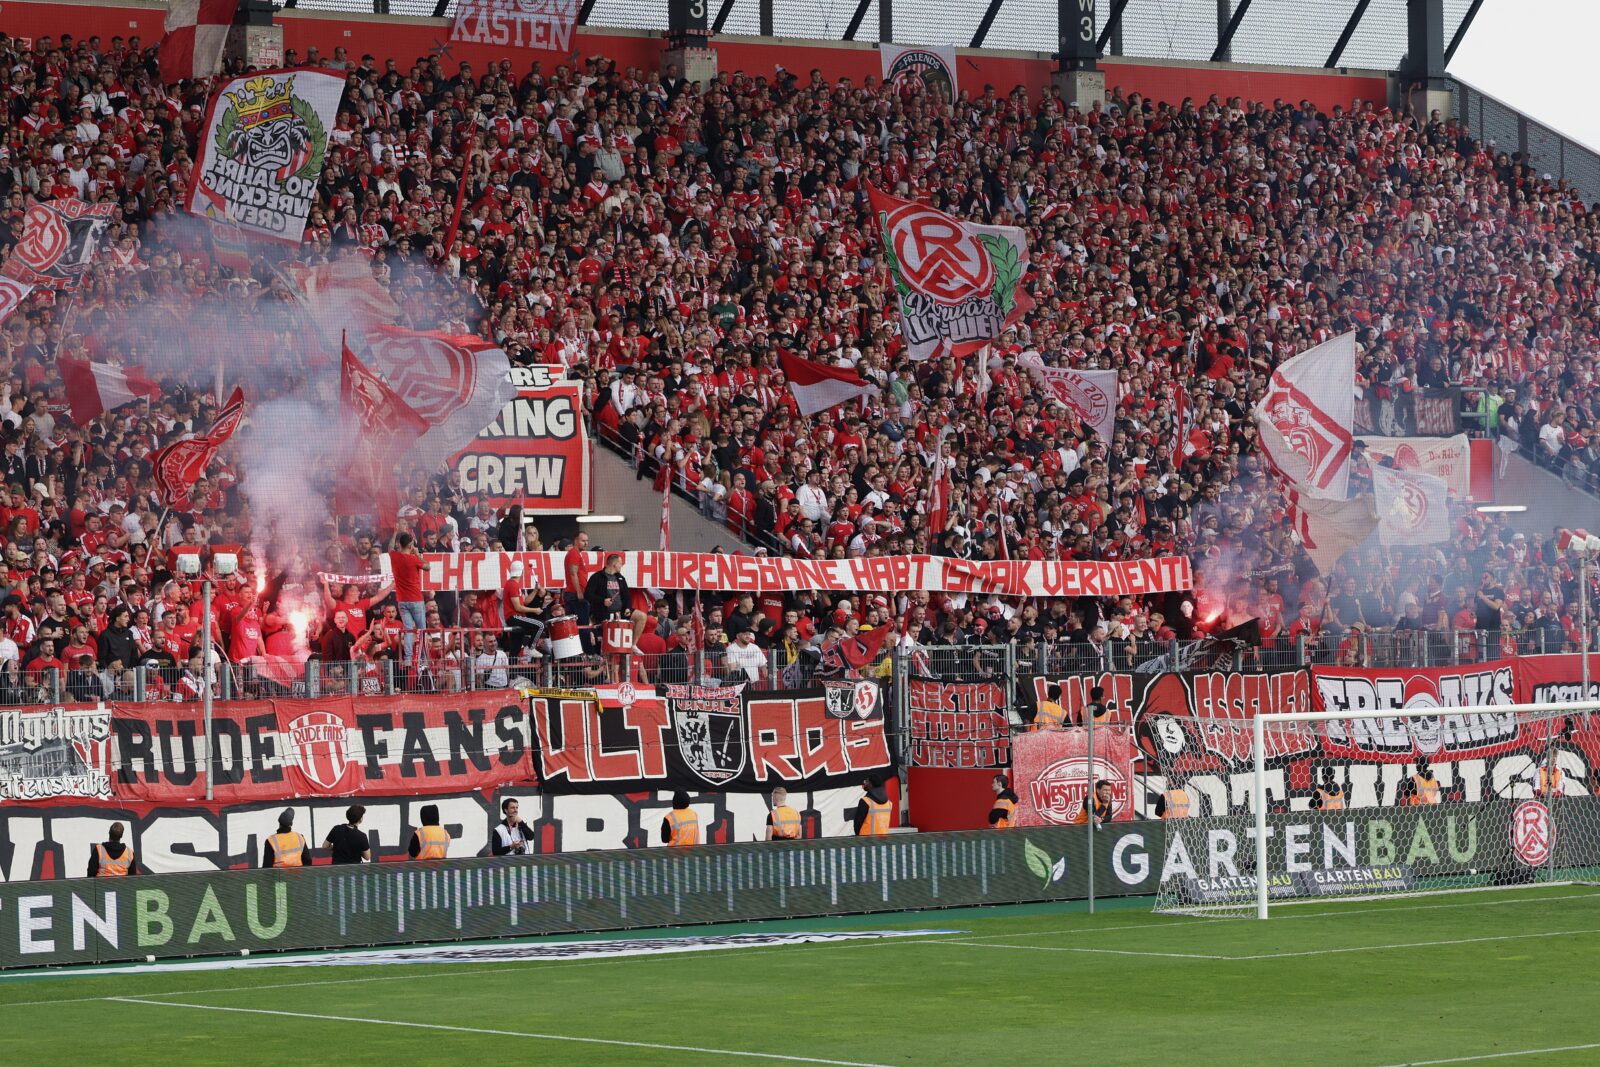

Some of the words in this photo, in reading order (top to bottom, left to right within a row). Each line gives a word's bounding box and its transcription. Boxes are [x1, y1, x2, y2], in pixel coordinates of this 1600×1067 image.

[451, 5, 575, 52] KASTEN
[1080, 16, 1093, 41] 3
[902, 53, 940, 70] FRIENDS
[458, 454, 564, 496] CREW
[637, 552, 838, 591] HURENSÖHNE
[853, 555, 930, 591] HABT
[941, 557, 1032, 596] ISMAIK
[1042, 556, 1189, 596] VERDIENT!
[910, 680, 1006, 711] SEKTION
[1316, 668, 1518, 753] FREAKS
[111, 713, 285, 786] RUDE
[356, 705, 524, 780] FANS
[293, 726, 322, 746] RUDE
[911, 709, 1009, 740] STADION
[1112, 815, 1478, 887] GARTENBAU
[1314, 867, 1403, 883] GARTENBAU
[0, 881, 288, 955] ENBAU
